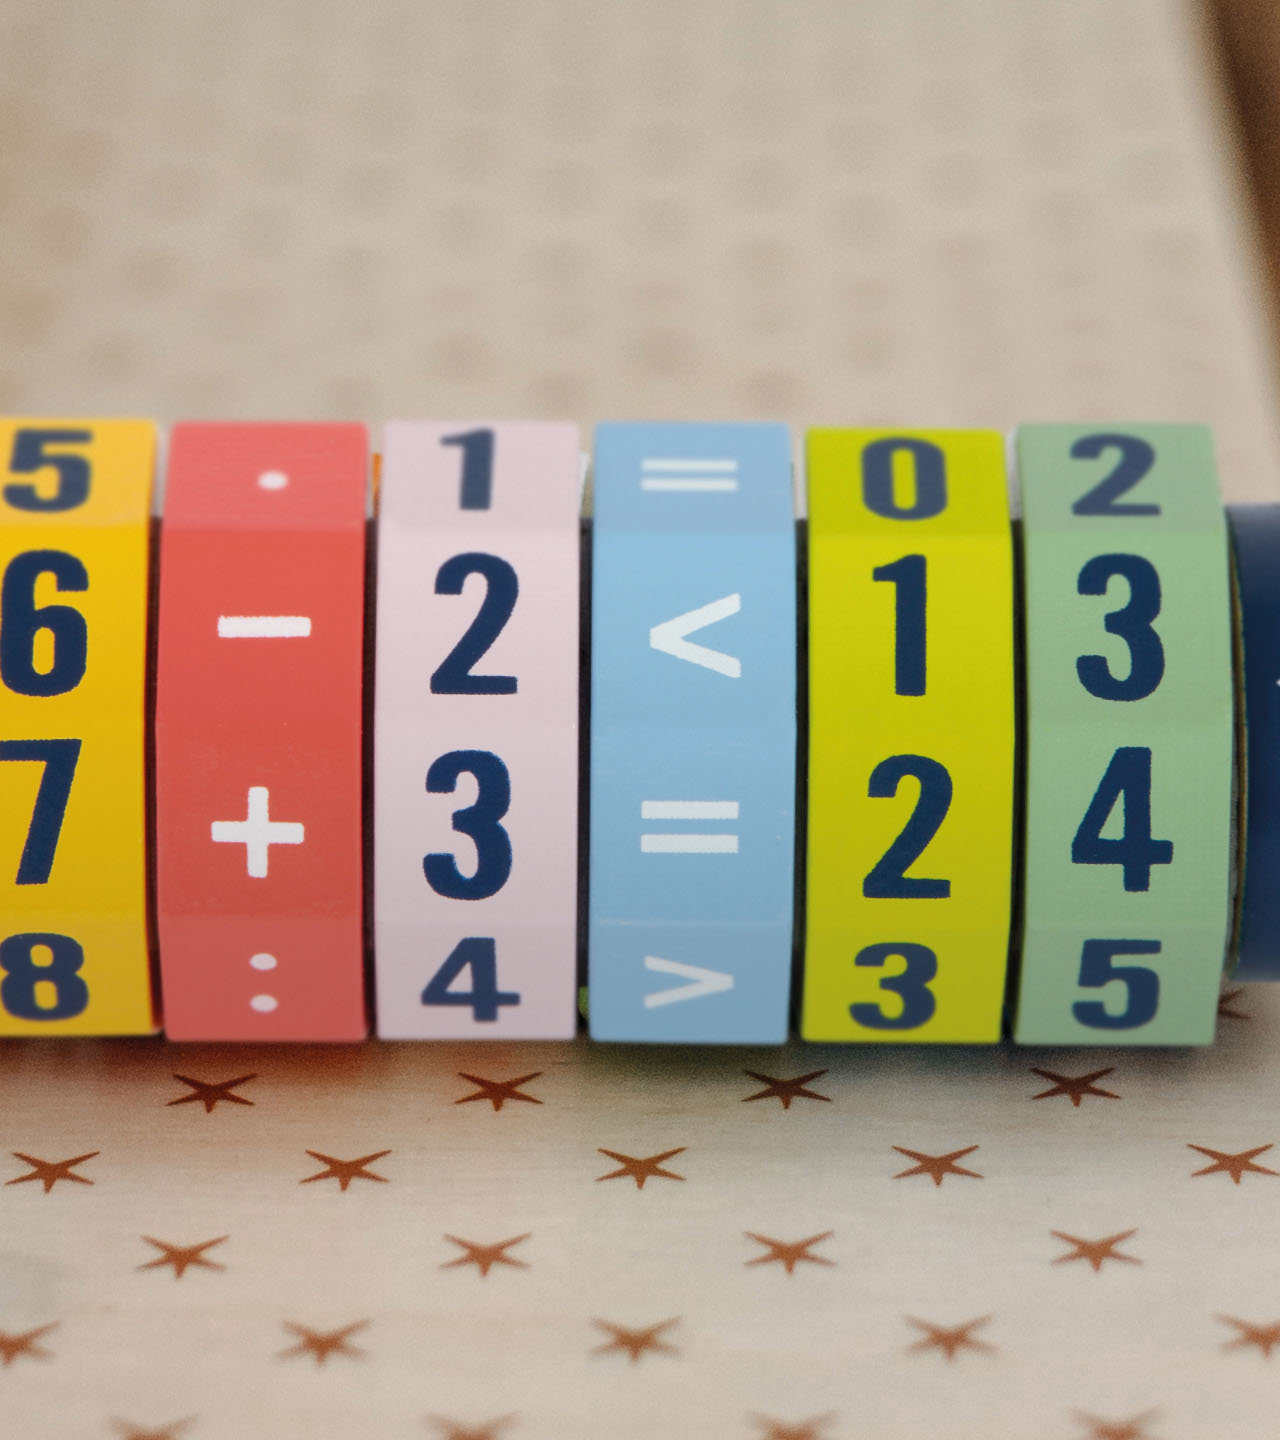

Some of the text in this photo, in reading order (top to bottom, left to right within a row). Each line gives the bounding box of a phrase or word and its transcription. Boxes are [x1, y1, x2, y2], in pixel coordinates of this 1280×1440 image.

[3, 429, 91, 513] 5
[440, 429, 494, 511] 1
[860, 436, 949, 521] 0
[1069, 432, 1163, 517] 2
[428, 550, 521, 697] 2
[647, 590, 743, 680] <
[870, 552, 929, 699] 1
[1073, 551, 1168, 704] 3
[209, 784, 307, 880] +
[421, 747, 515, 902] 3
[639, 798, 741, 855] =
[860, 752, 955, 902] 2
[1069, 744, 1176, 895] 4
[419, 935, 522, 1024] 4
[644, 955, 734, 1010] >
[847, 940, 940, 1032] 3
[1069, 936, 1164, 1033] 5
